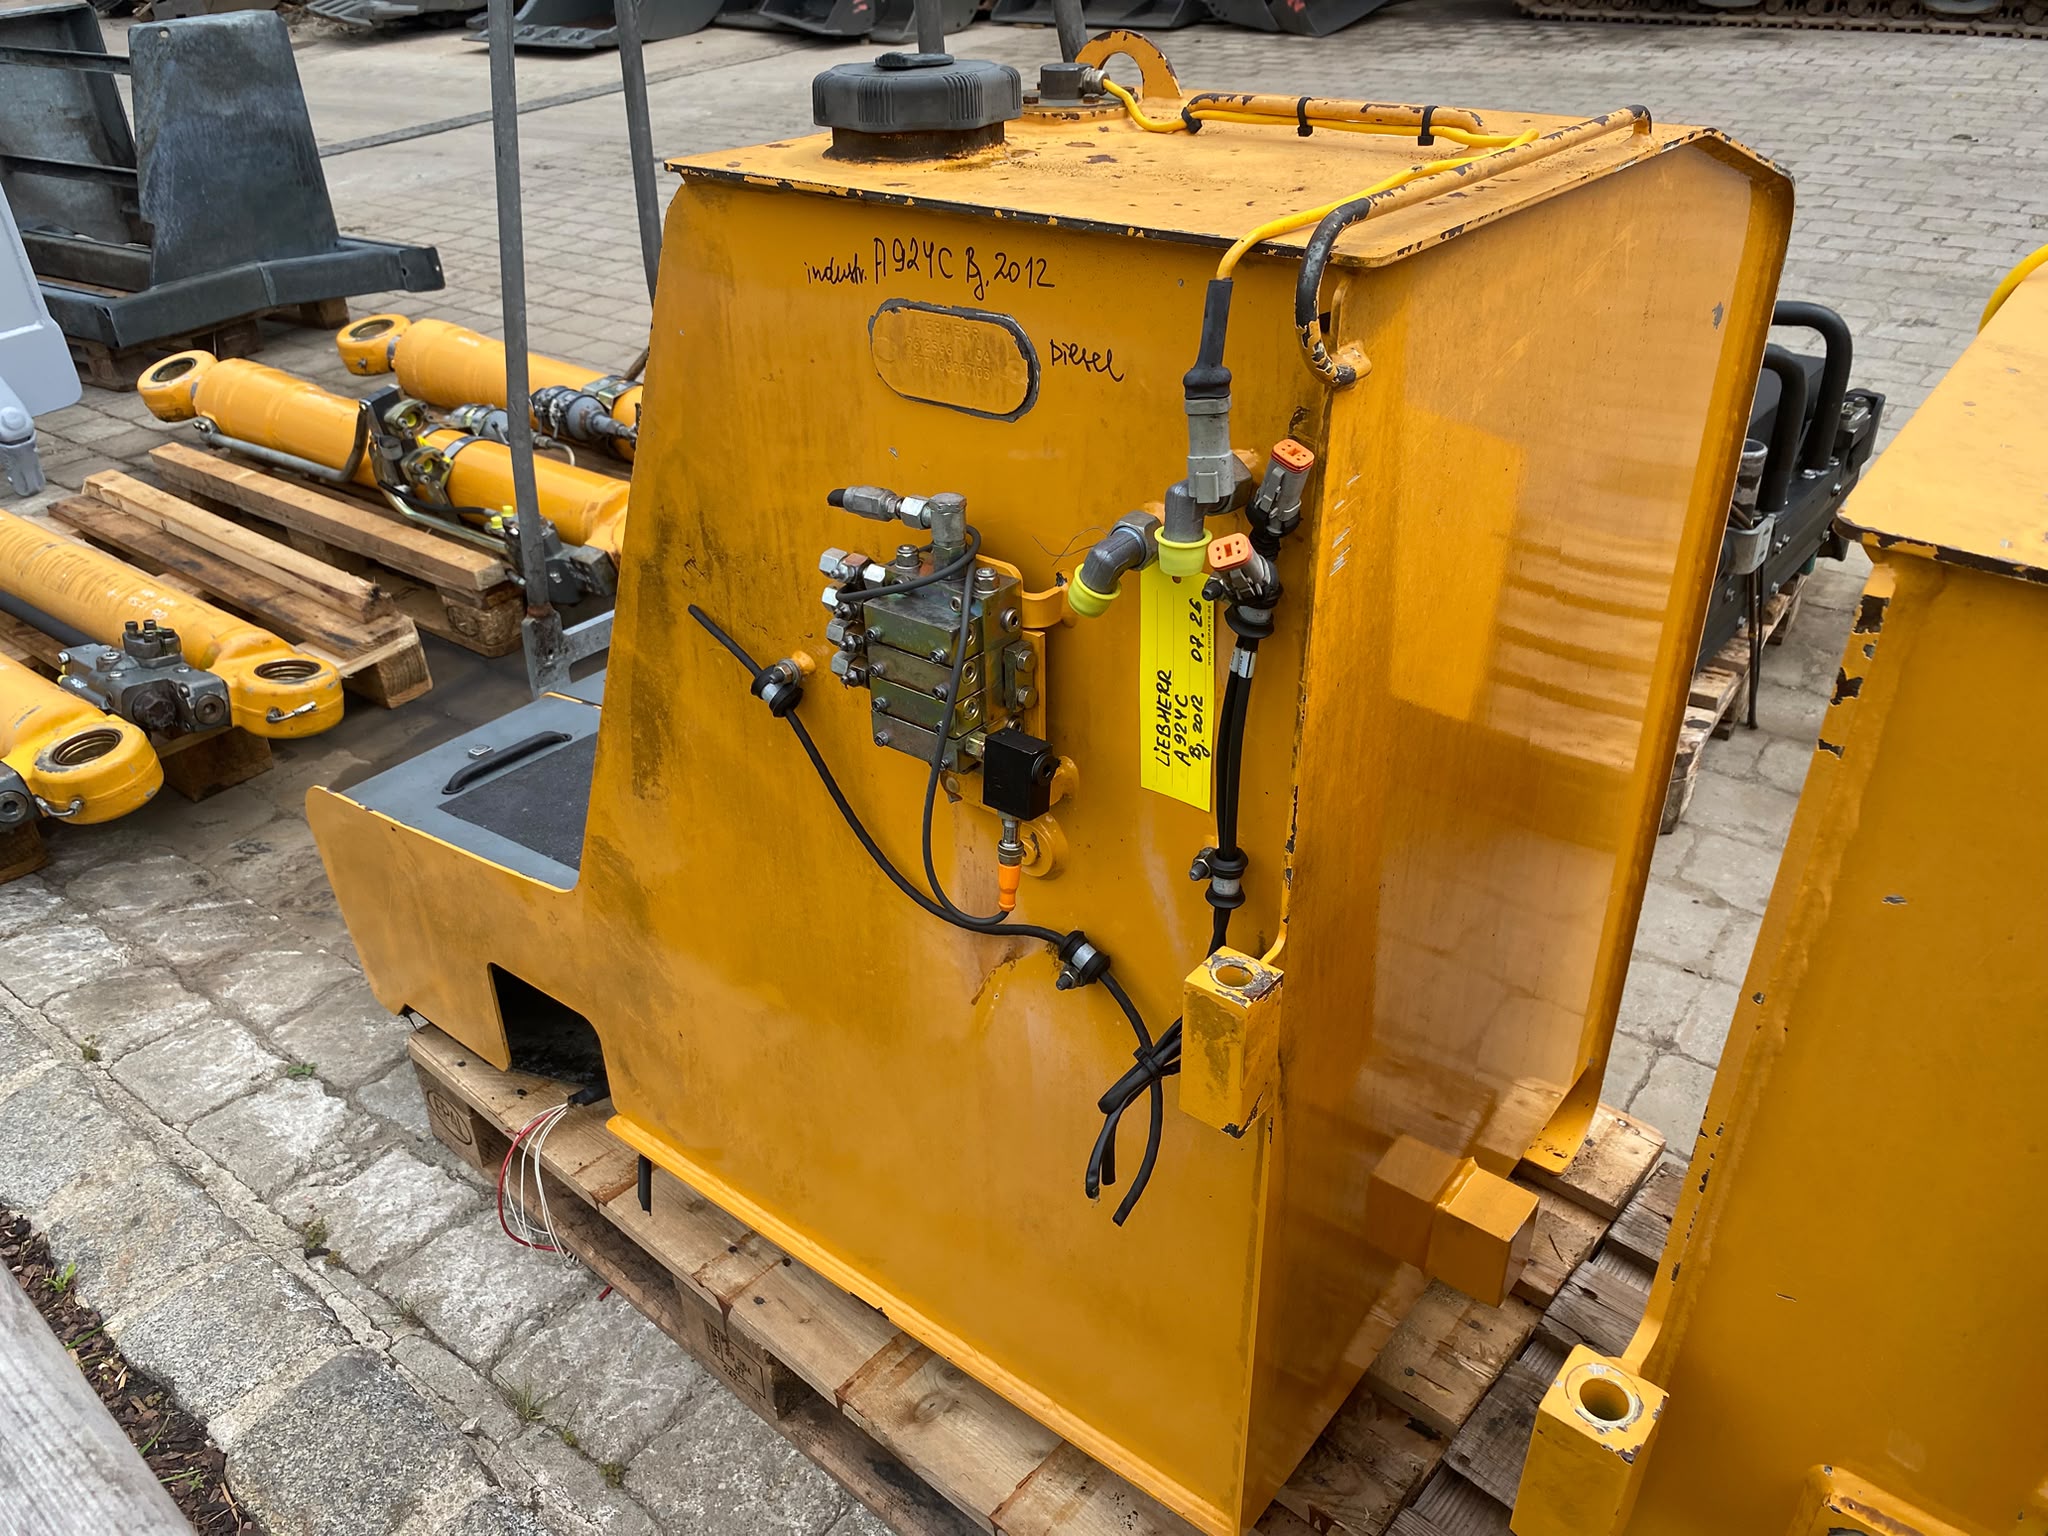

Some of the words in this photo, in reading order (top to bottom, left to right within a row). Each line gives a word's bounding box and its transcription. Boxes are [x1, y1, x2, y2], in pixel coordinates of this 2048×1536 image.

[993, 252, 1056, 289] 2012
[912, 317, 981, 343] LIEBHERR
[1049, 338, 1126, 383] Diesel
[1190, 694, 1204, 734] 2012
